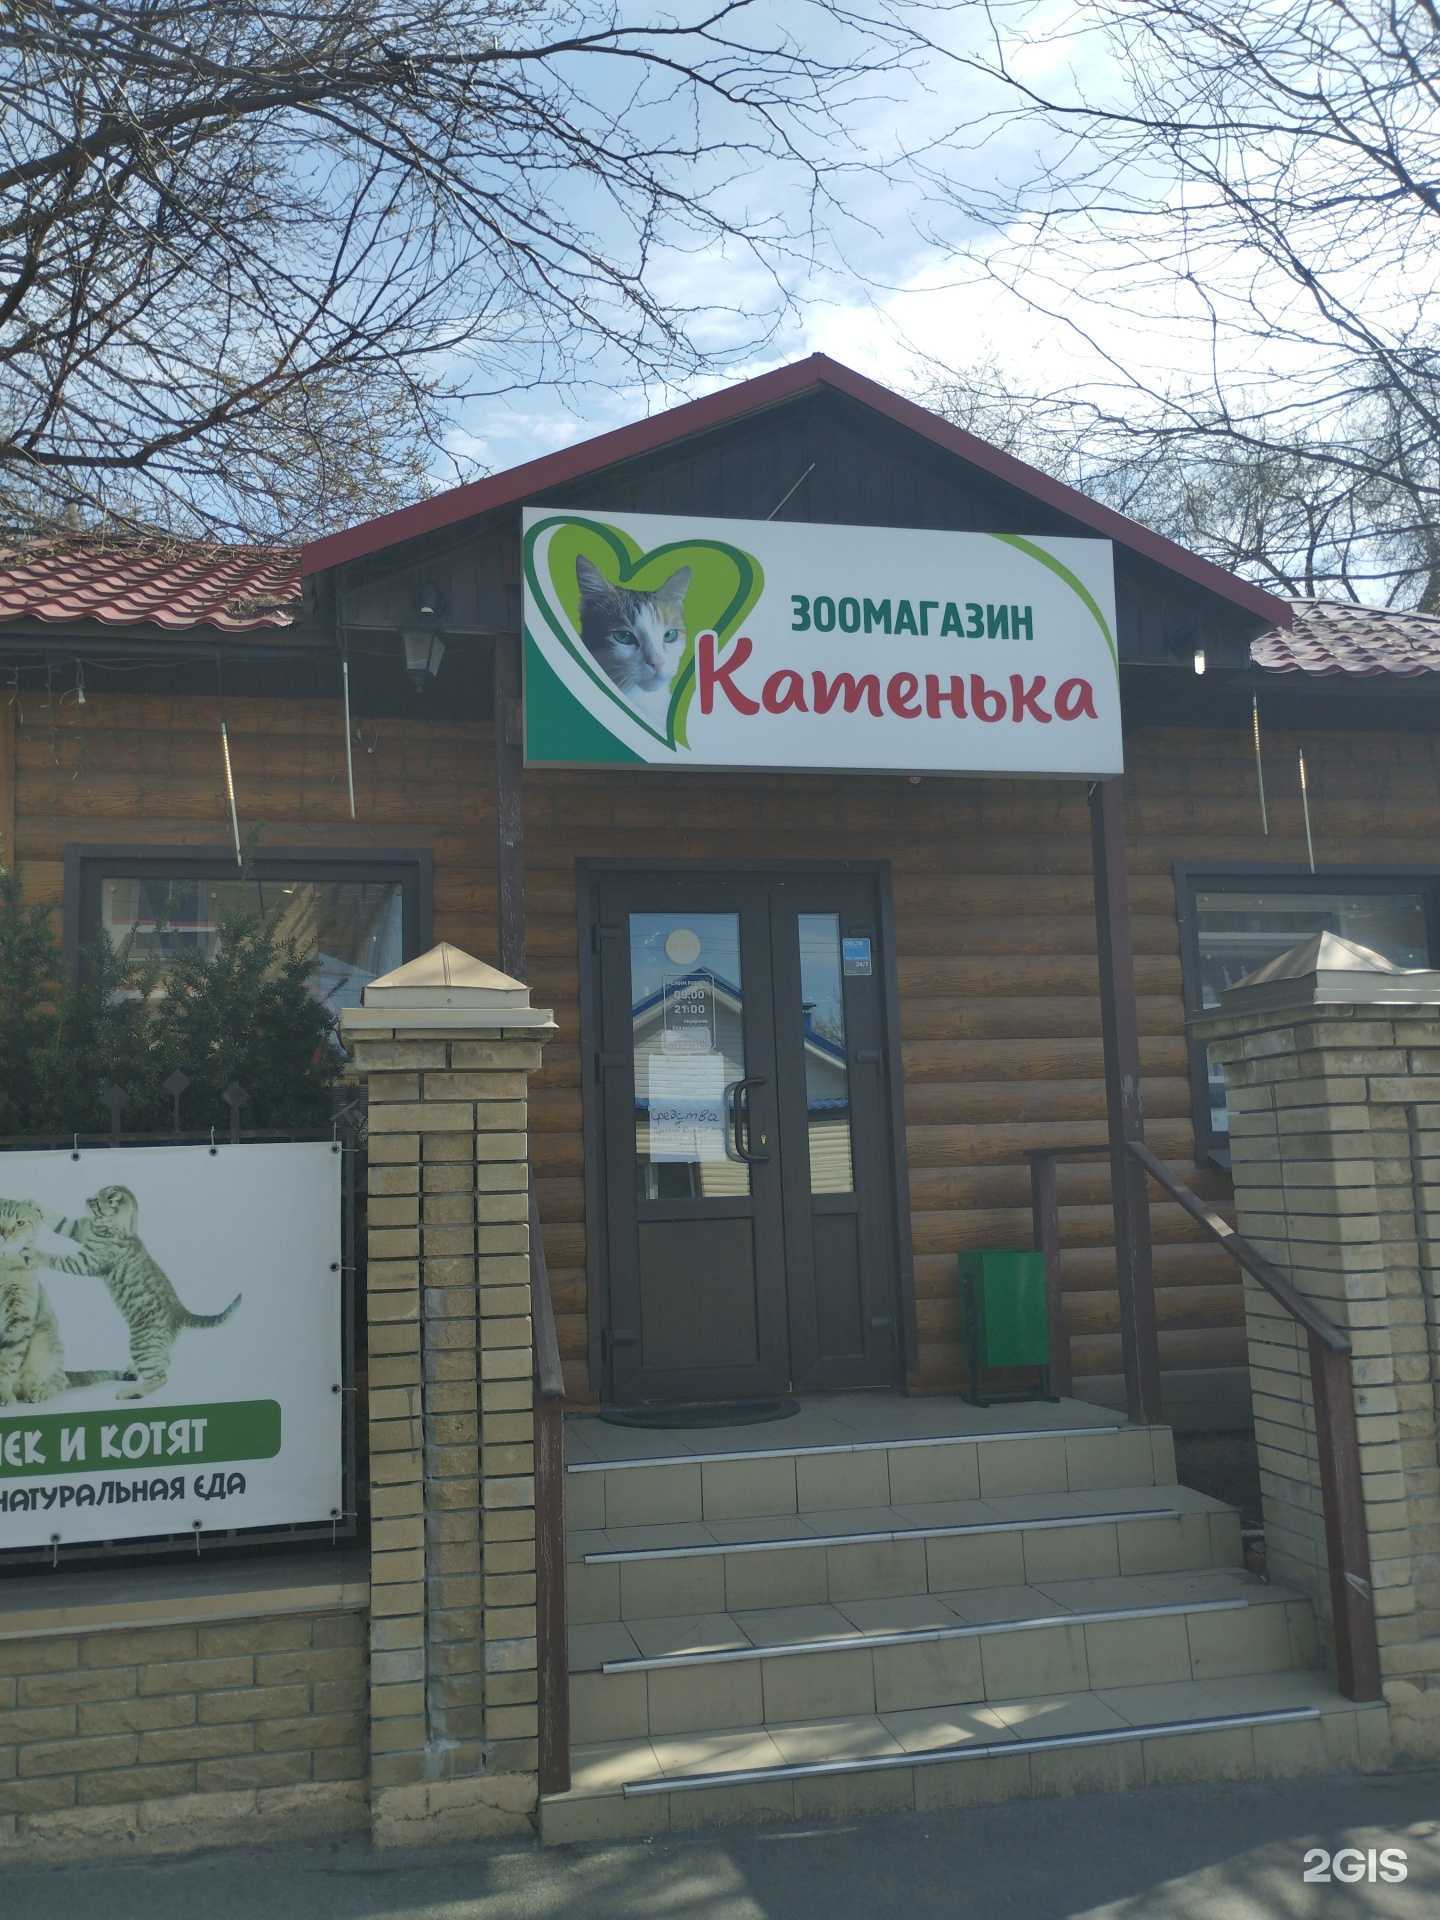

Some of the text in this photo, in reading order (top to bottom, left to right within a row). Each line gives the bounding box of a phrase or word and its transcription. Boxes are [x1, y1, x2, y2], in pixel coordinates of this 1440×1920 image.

[790, 594, 1035, 641] ЗООМАГАЗИН
[697, 634, 1099, 724] Катенька
[674, 1004, 705, 1014] 21:00
[0, 1418, 208, 1467] ЕК И КОТЯТ
[193, 1472, 247, 1501] ЕДА
